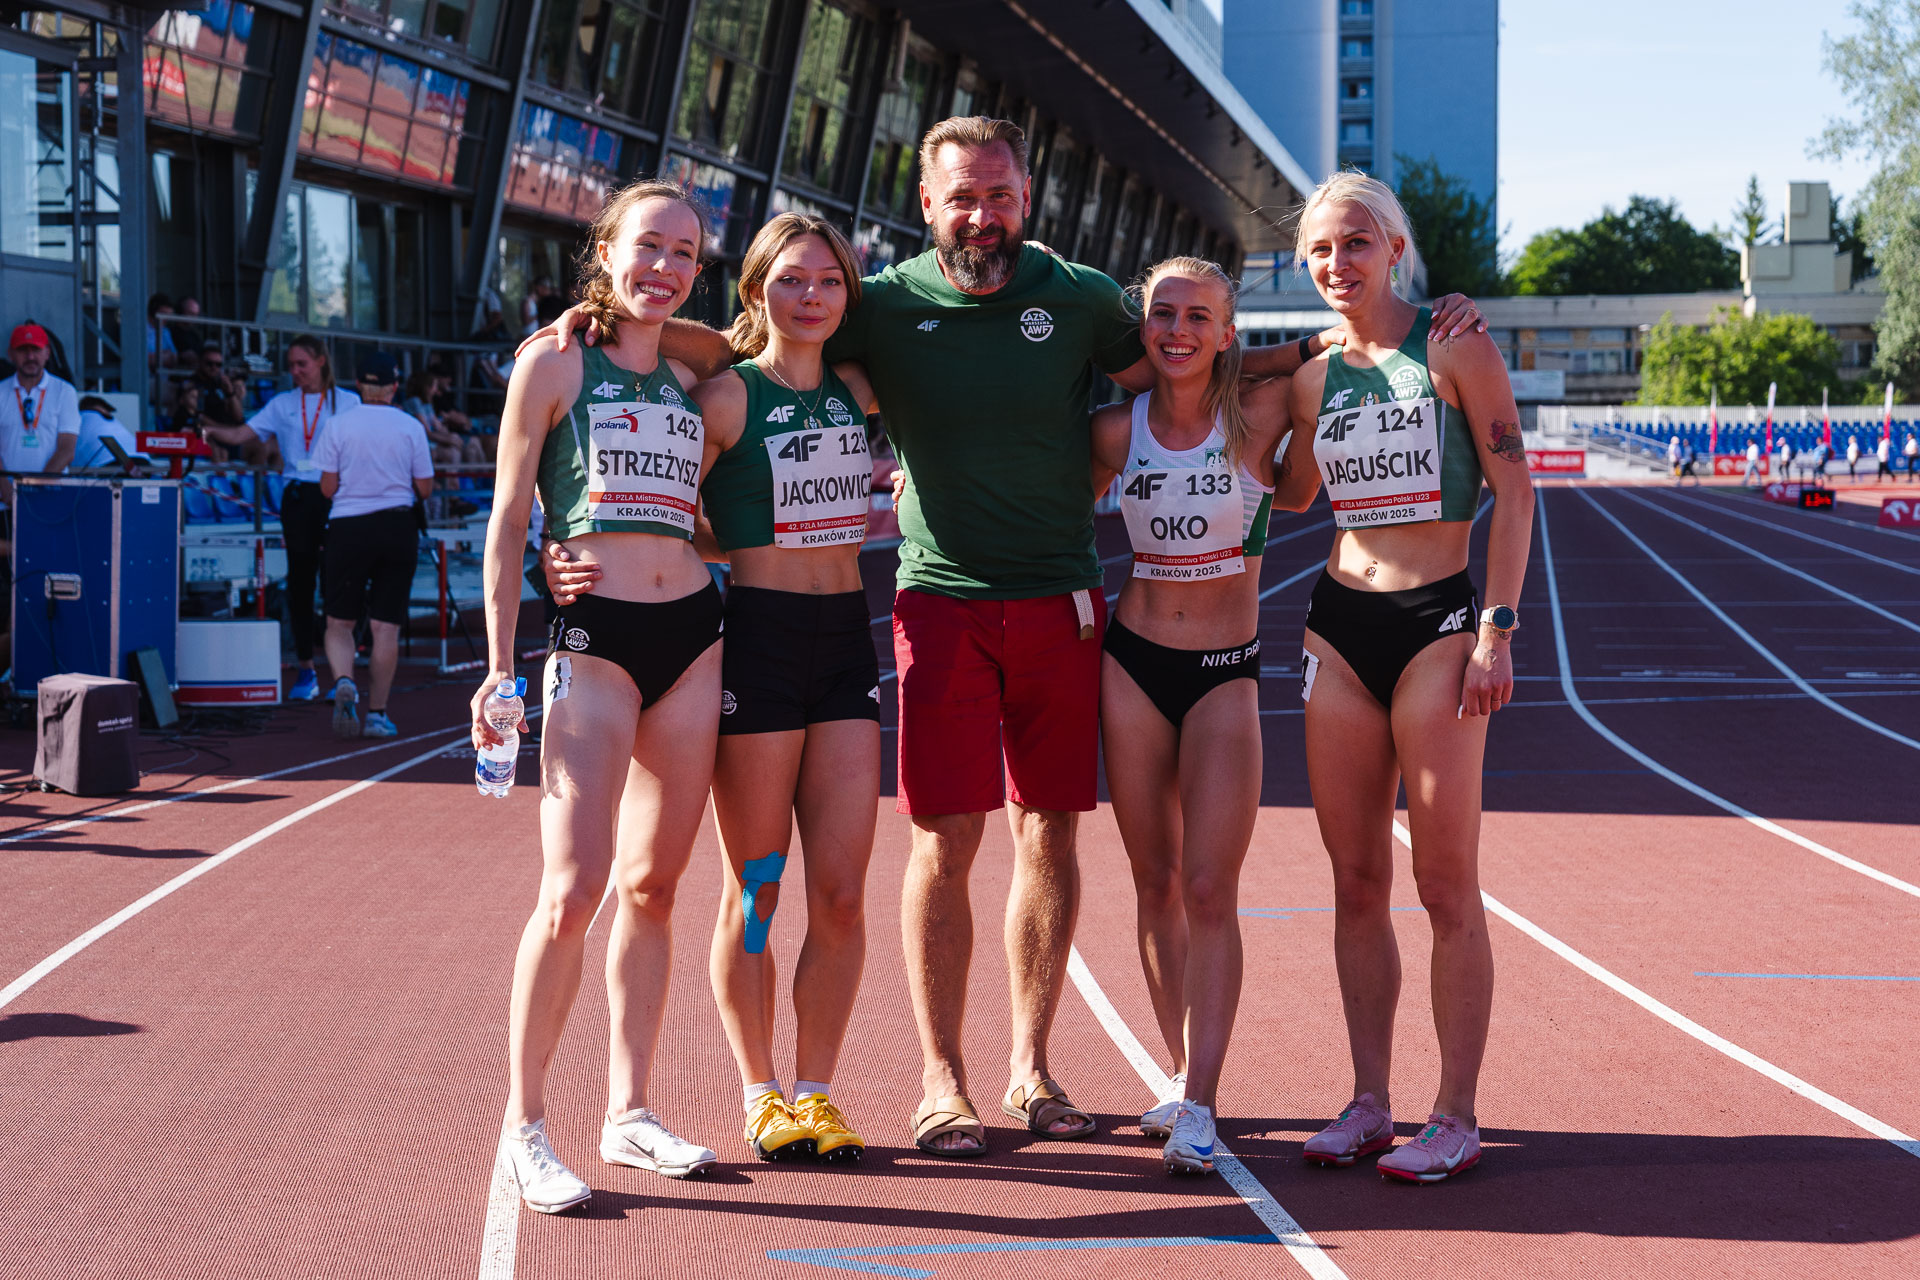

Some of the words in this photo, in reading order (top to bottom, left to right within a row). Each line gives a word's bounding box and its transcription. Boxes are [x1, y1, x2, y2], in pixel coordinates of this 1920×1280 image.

[1027, 313, 1046, 321] AZS
[917, 319, 941, 332] 4F
[1027, 325, 1049, 335] AWF
[592, 381, 624, 399] 4F
[1394, 386, 1417, 399] AWF
[1326, 388, 1354, 409] 4F
[765, 405, 796, 423] 4F
[594, 421, 630, 431] polanik
[665, 413, 698, 441] 142
[1320, 412, 1361, 443] 4F
[1377, 406, 1424, 433] 124
[777, 433, 823, 463] 4F
[838, 432, 867, 455] 123
[596, 448, 699, 488] STRZEŻYSZ
[1325, 448, 1435, 486] JAGUŚCIK
[1124, 472, 1169, 500] 4F
[1185, 474, 1232, 496] 133
[602, 493, 614, 501] 42.
[635, 494, 674, 506] Mistrzostwa
[1356, 498, 1393, 508] Mistrzostwa
[1393, 494, 1413, 503] Polski
[1415, 493, 1430, 501] U23
[617, 506, 669, 519] KRAKÓW
[670, 511, 686, 524] 2025
[1347, 509, 1388, 523] KRAKÓW
[1390, 508, 1416, 519] 2025
[787, 523, 799, 531] 42.
[800, 521, 816, 530] PZLA
[817, 518, 852, 529] Mistrzostwa
[1150, 515, 1209, 541] OKO
[801, 530, 847, 545] KRAKÓW
[1161, 556, 1198, 564] Mistrzostwa
[1200, 553, 1219, 562] Polski
[1220, 549, 1233, 557] U23
[1150, 566, 1192, 578] KRAKÓW
[1194, 564, 1222, 577] 2025
[1438, 606, 1469, 633] 4F
[1201, 651, 1242, 667] NIKE
